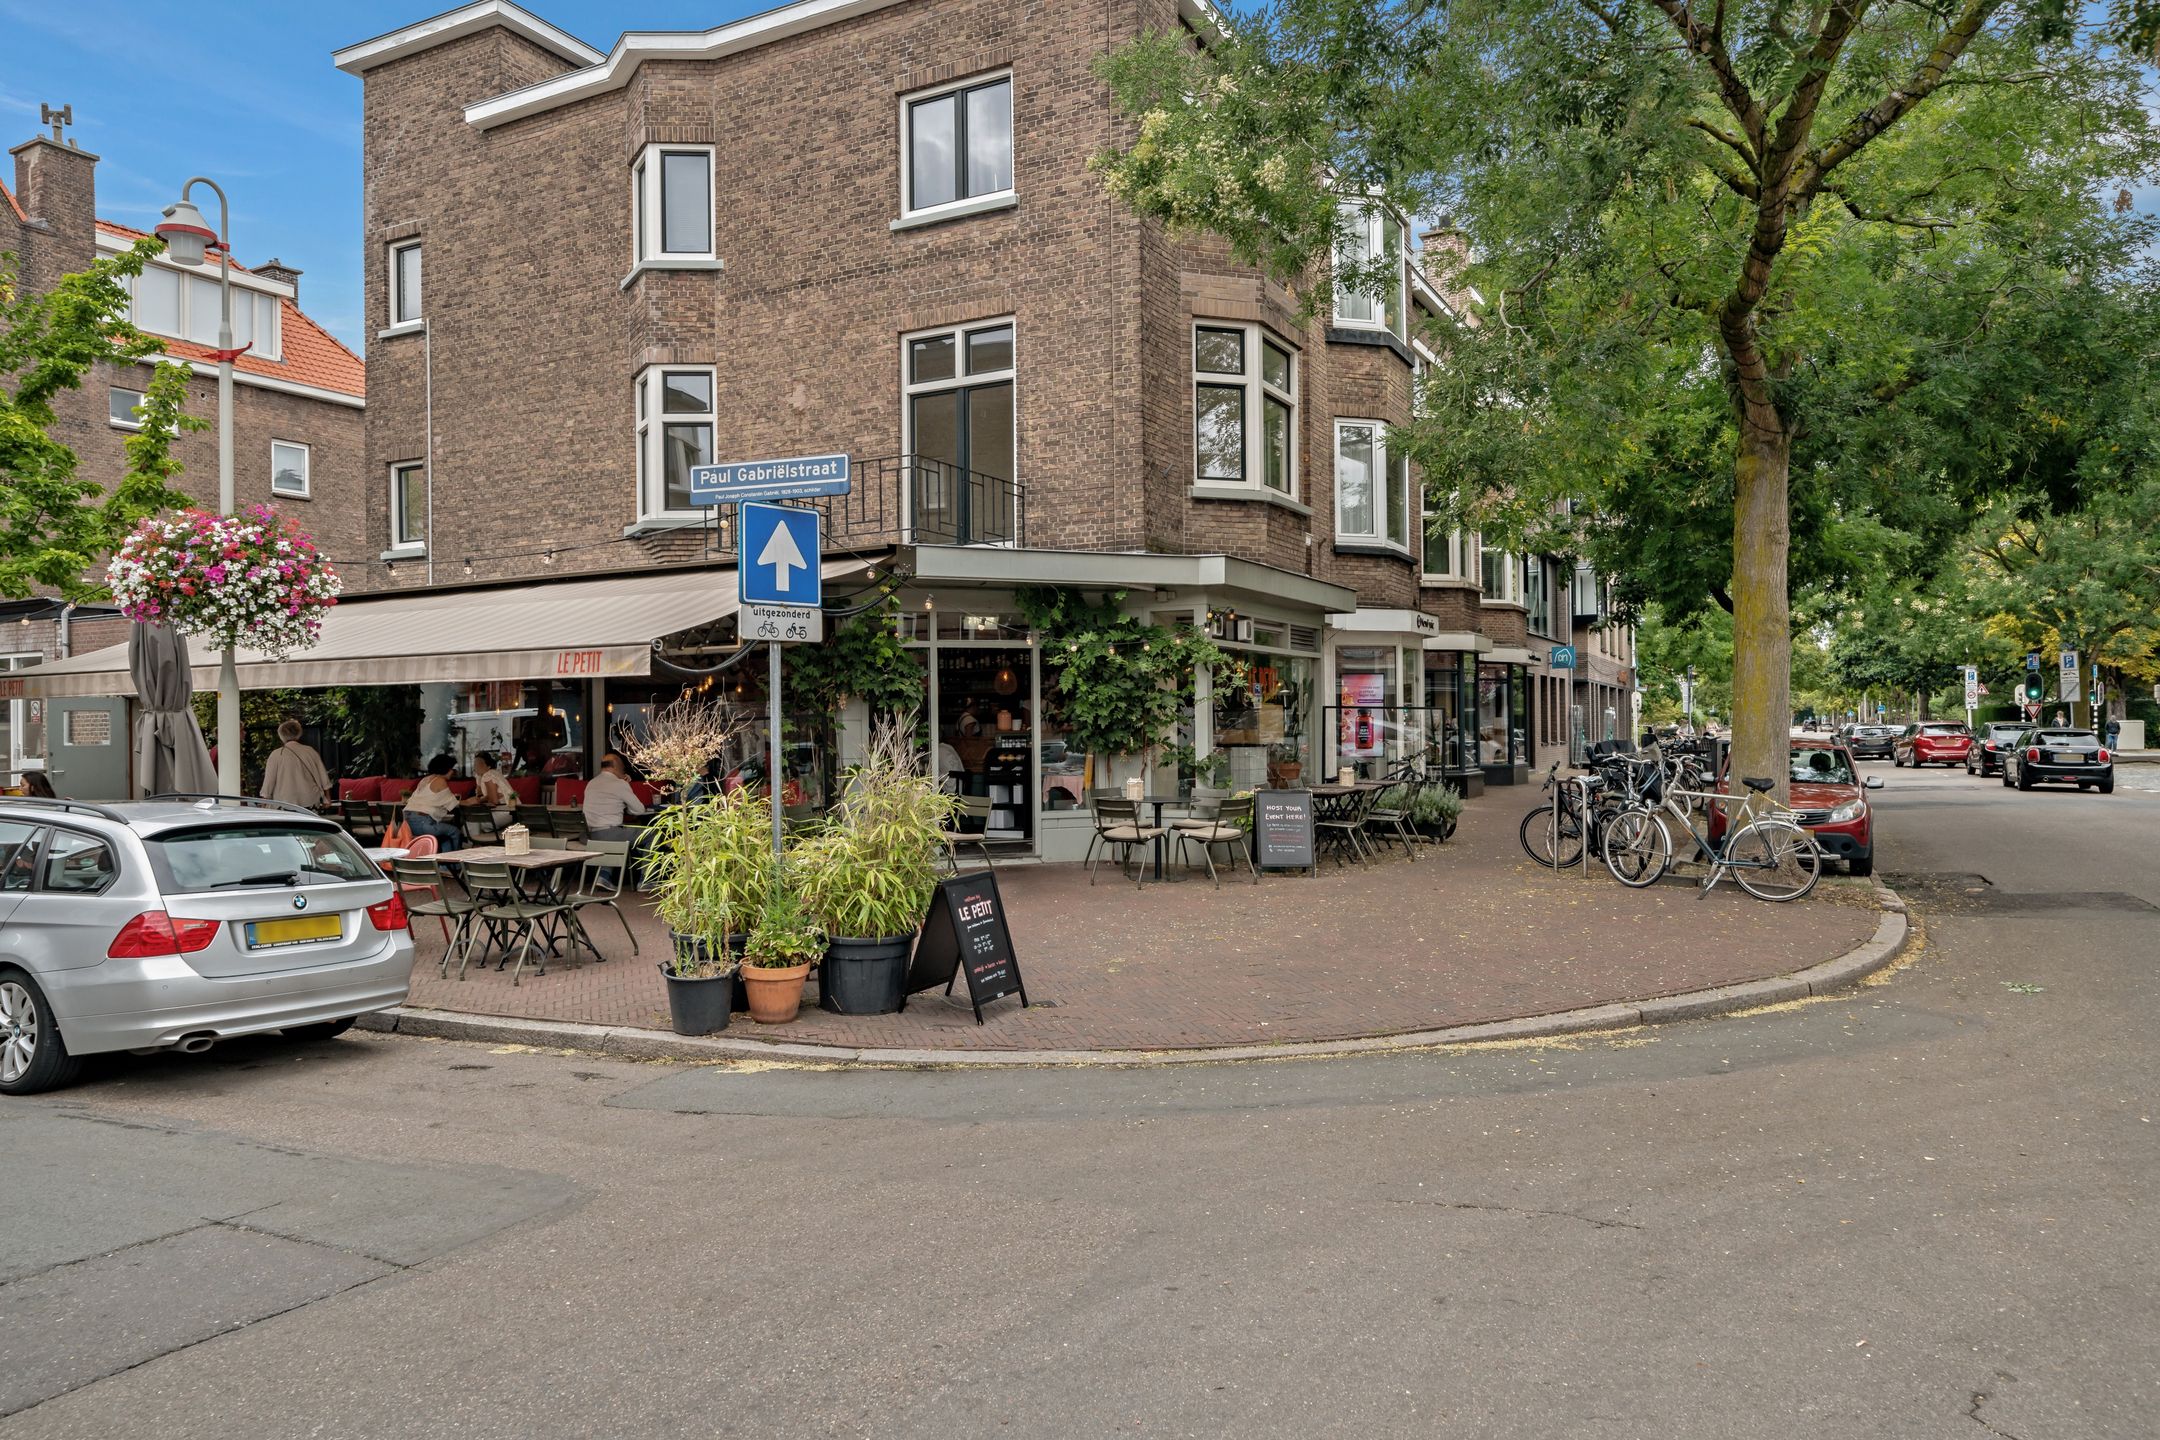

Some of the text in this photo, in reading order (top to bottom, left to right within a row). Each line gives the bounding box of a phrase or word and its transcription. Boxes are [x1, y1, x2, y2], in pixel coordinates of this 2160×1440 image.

[700, 461, 837, 485] Paul Gabriëlstraat
[753, 608, 811, 619] uitgezonderd
[557, 652, 571, 674] LE
[573, 651, 603, 673] PETIT
[0, 681, 7, 697] LE
[9, 680, 24, 697] PETIT
[958, 900, 992, 922] LE PETIT
